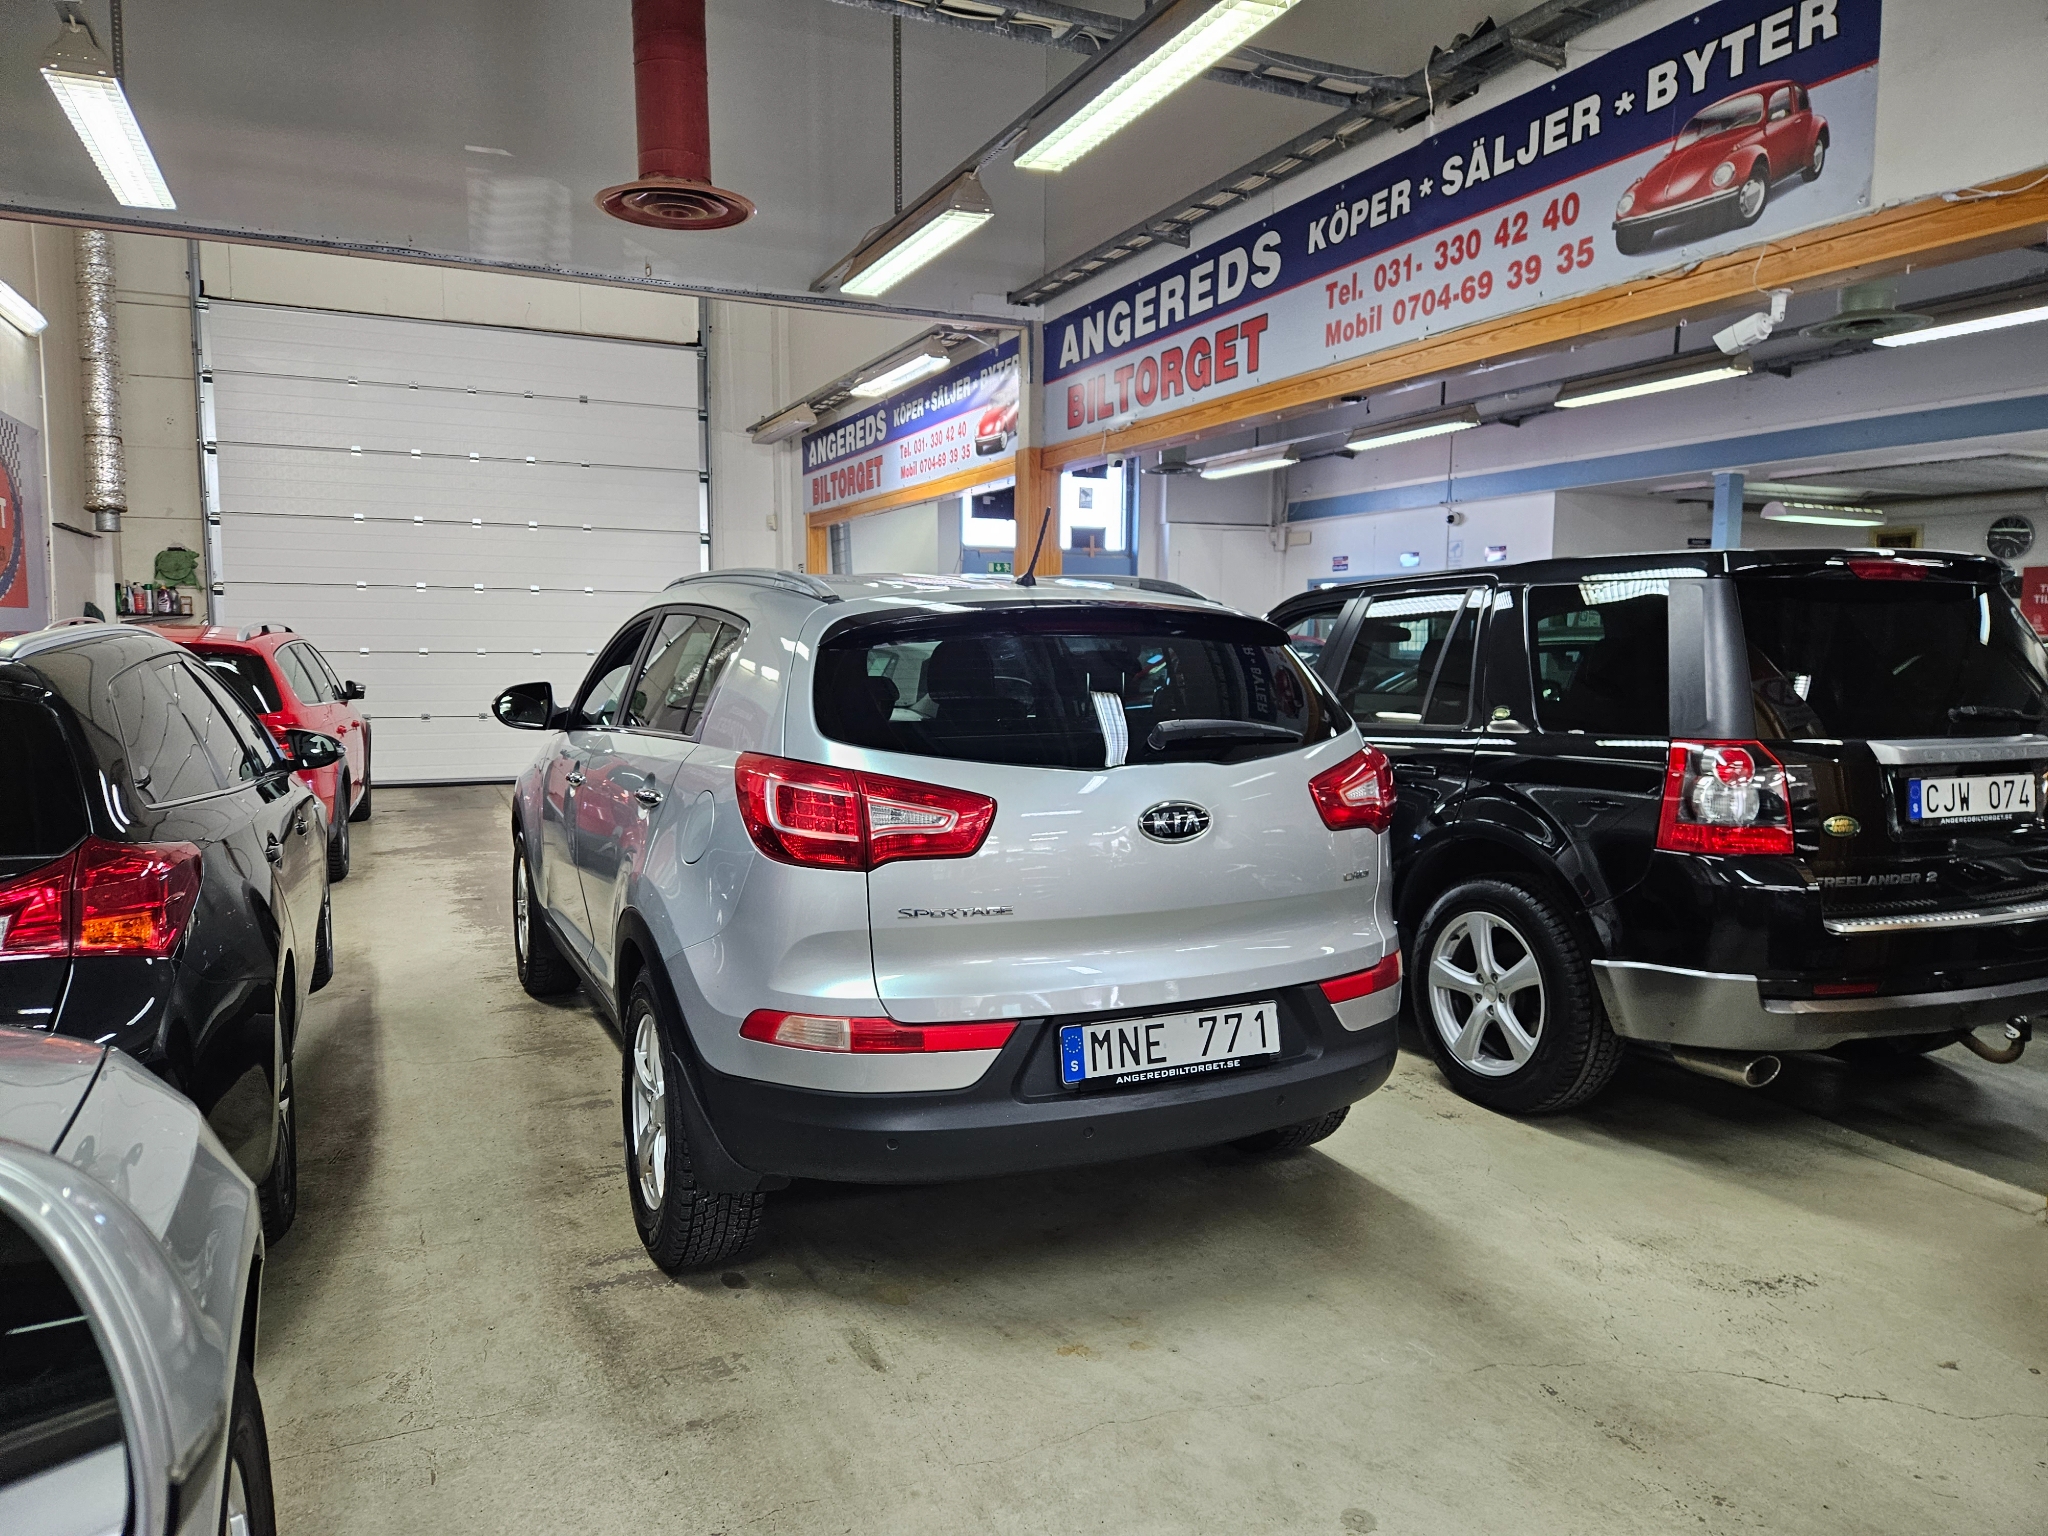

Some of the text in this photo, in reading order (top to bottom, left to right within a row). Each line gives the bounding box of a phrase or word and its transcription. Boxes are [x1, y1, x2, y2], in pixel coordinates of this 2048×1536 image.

[1308, 0, 1838, 254] KÖPER SÄLJER BYTER
[1325, 272, 1363, 310] Tel.
[1433, 228, 1482, 271] 330
[1494, 211, 1528, 248] 42
[1542, 192, 1580, 231] 40
[1059, 230, 1282, 369] ANGEREDS
[1325, 235, 1595, 348] Mobil 0704-69 39 35
[1067, 313, 1268, 430] BILTORGET
[893, 397, 924, 427] KÖPER
[931, 376, 971, 412] SÄLJER
[809, 409, 887, 467] ANGEREDS
[900, 442, 911, 459] Tel.
[930, 430, 943, 449] 330
[946, 425, 955, 442] 42
[958, 421, 967, 438] 40
[901, 444, 971, 479] Mobil 0704-69 39 35
[812, 455, 884, 506] BILTORGET
[1926, 779, 2030, 813] CJW 074
[1152, 810, 1201, 835] KIA
[1816, 871, 1938, 888] FREELANDER 2
[898, 906, 1013, 919] SPORTAGE
[1070, 1060, 1079, 1072] S
[1090, 1010, 1267, 1072] MNE 771
[1116, 1059, 1241, 1085] ANGEREDBILTORGET.SE
